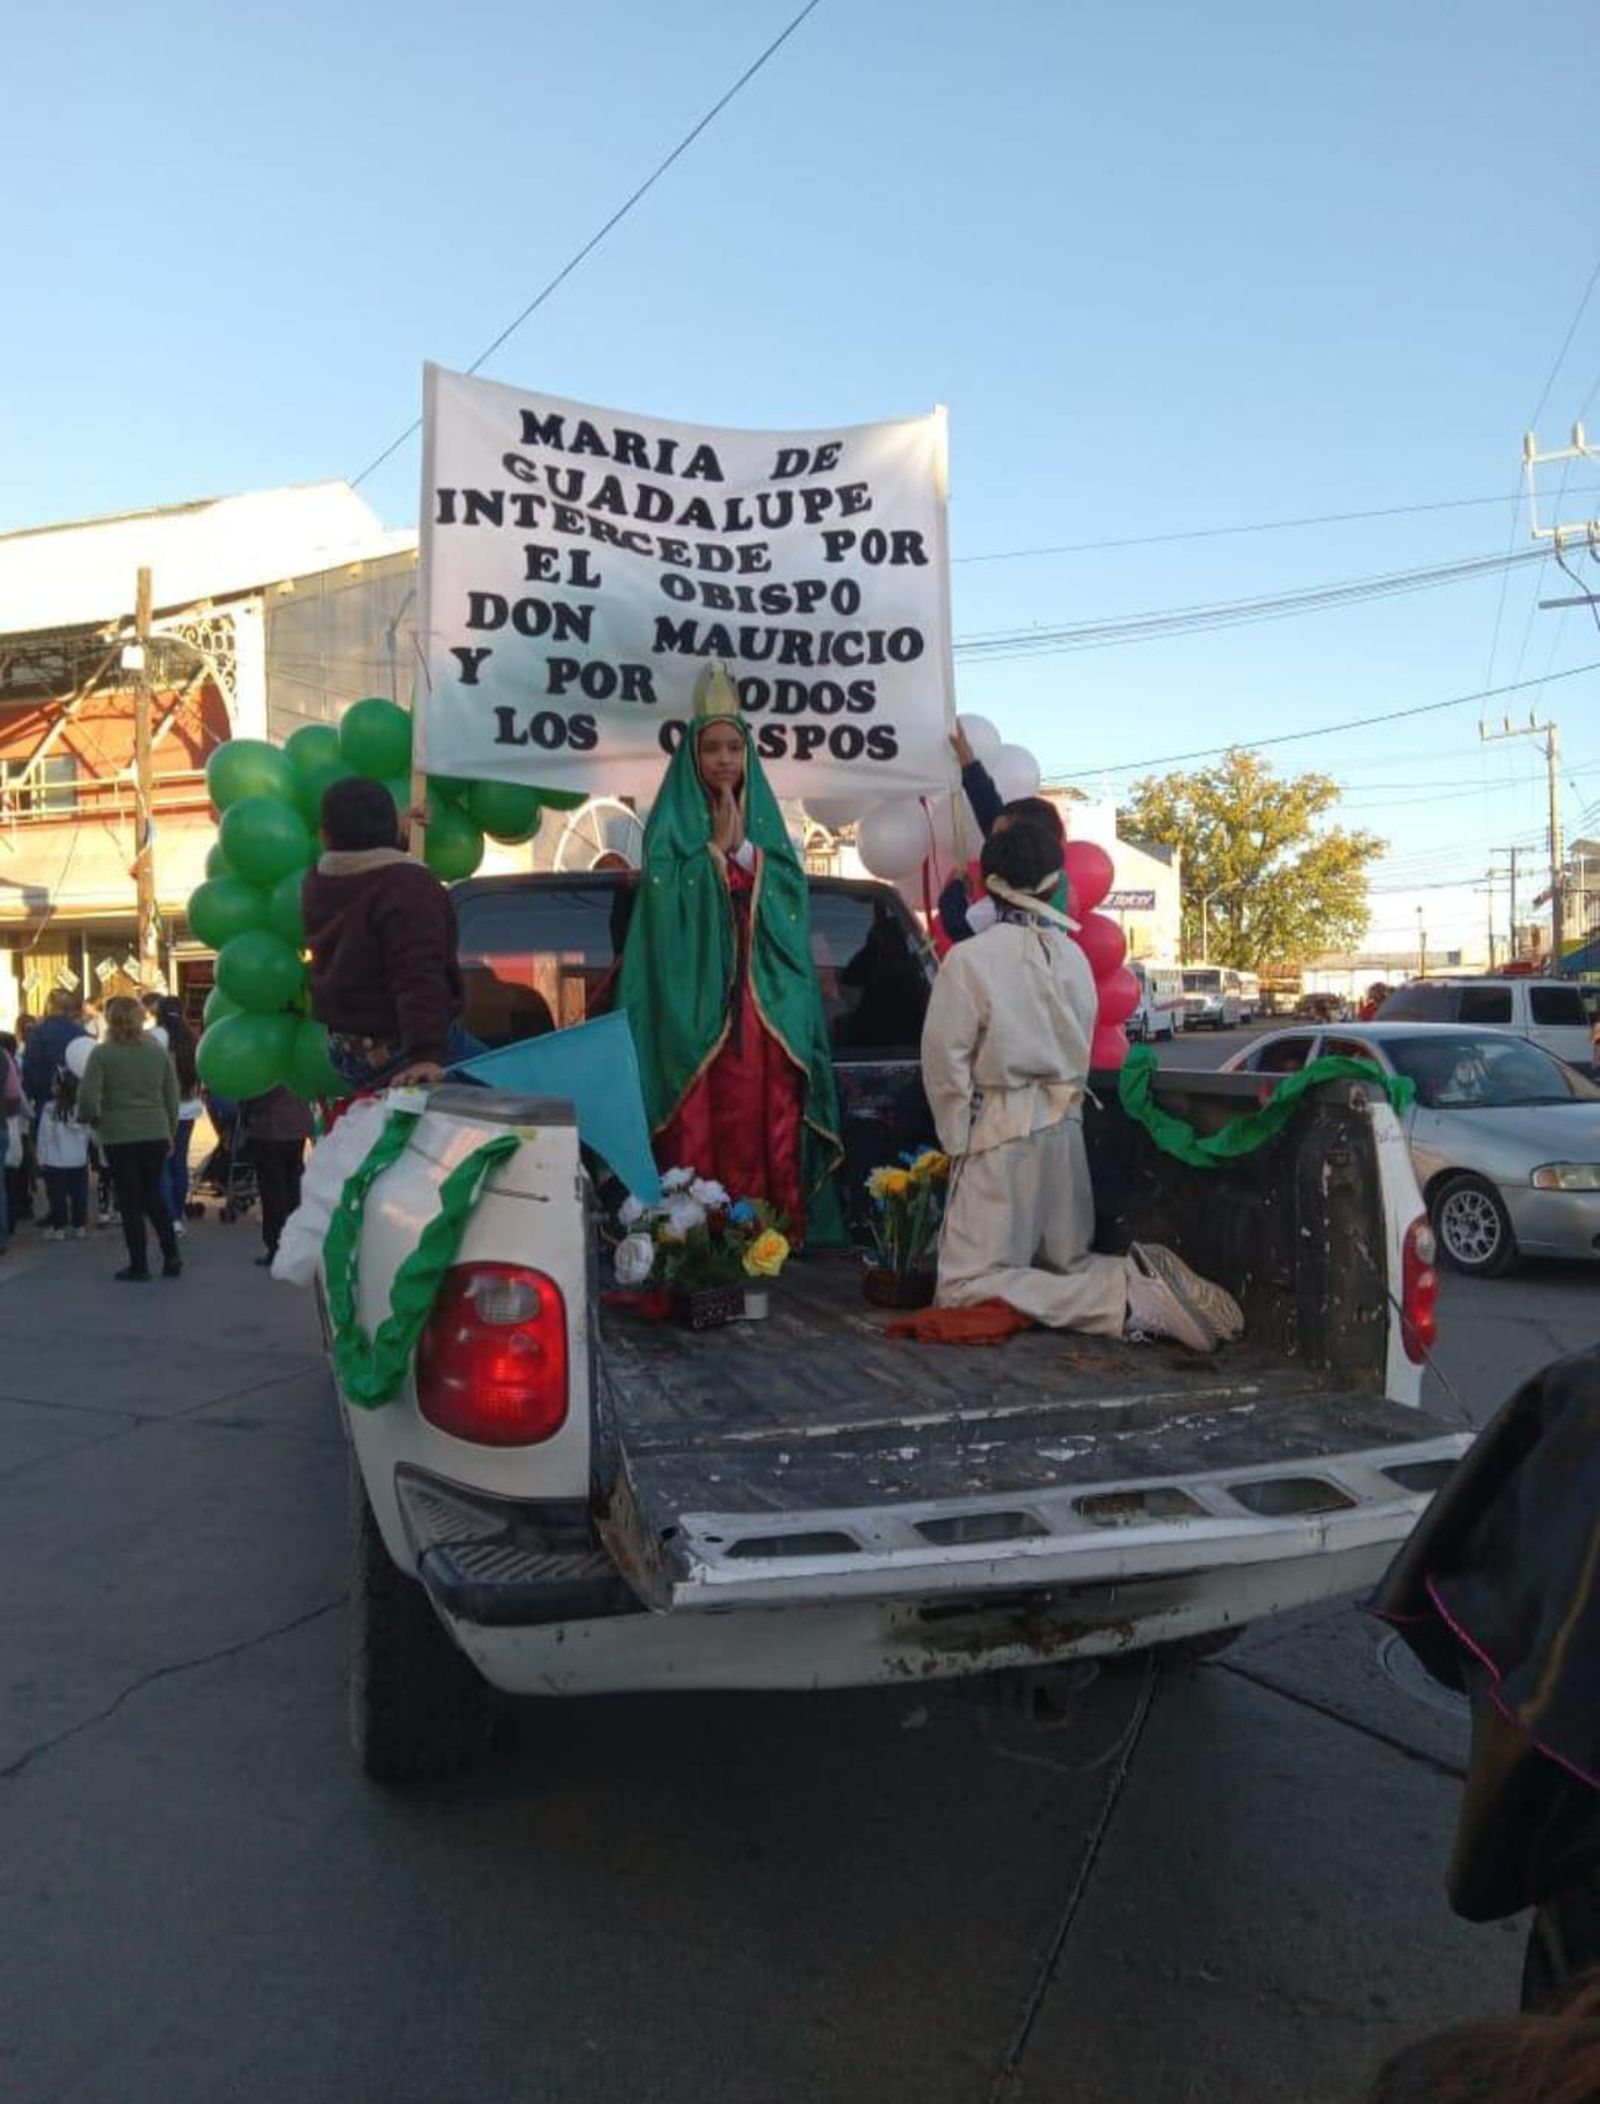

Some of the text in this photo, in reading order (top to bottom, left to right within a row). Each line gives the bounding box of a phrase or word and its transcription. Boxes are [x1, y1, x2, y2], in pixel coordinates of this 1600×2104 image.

[520, 409, 844, 482] MARIA DE
[502, 453, 872, 533] GUADALUPE
[436, 488, 928, 575] INTERCEDE POR
[524, 544, 861, 616] EL OBISPO
[466, 592, 924, 668] DON MAURICIO
[450, 647, 876, 716] Y POR ODOS
[493, 705, 899, 761] LOS OSPOS
